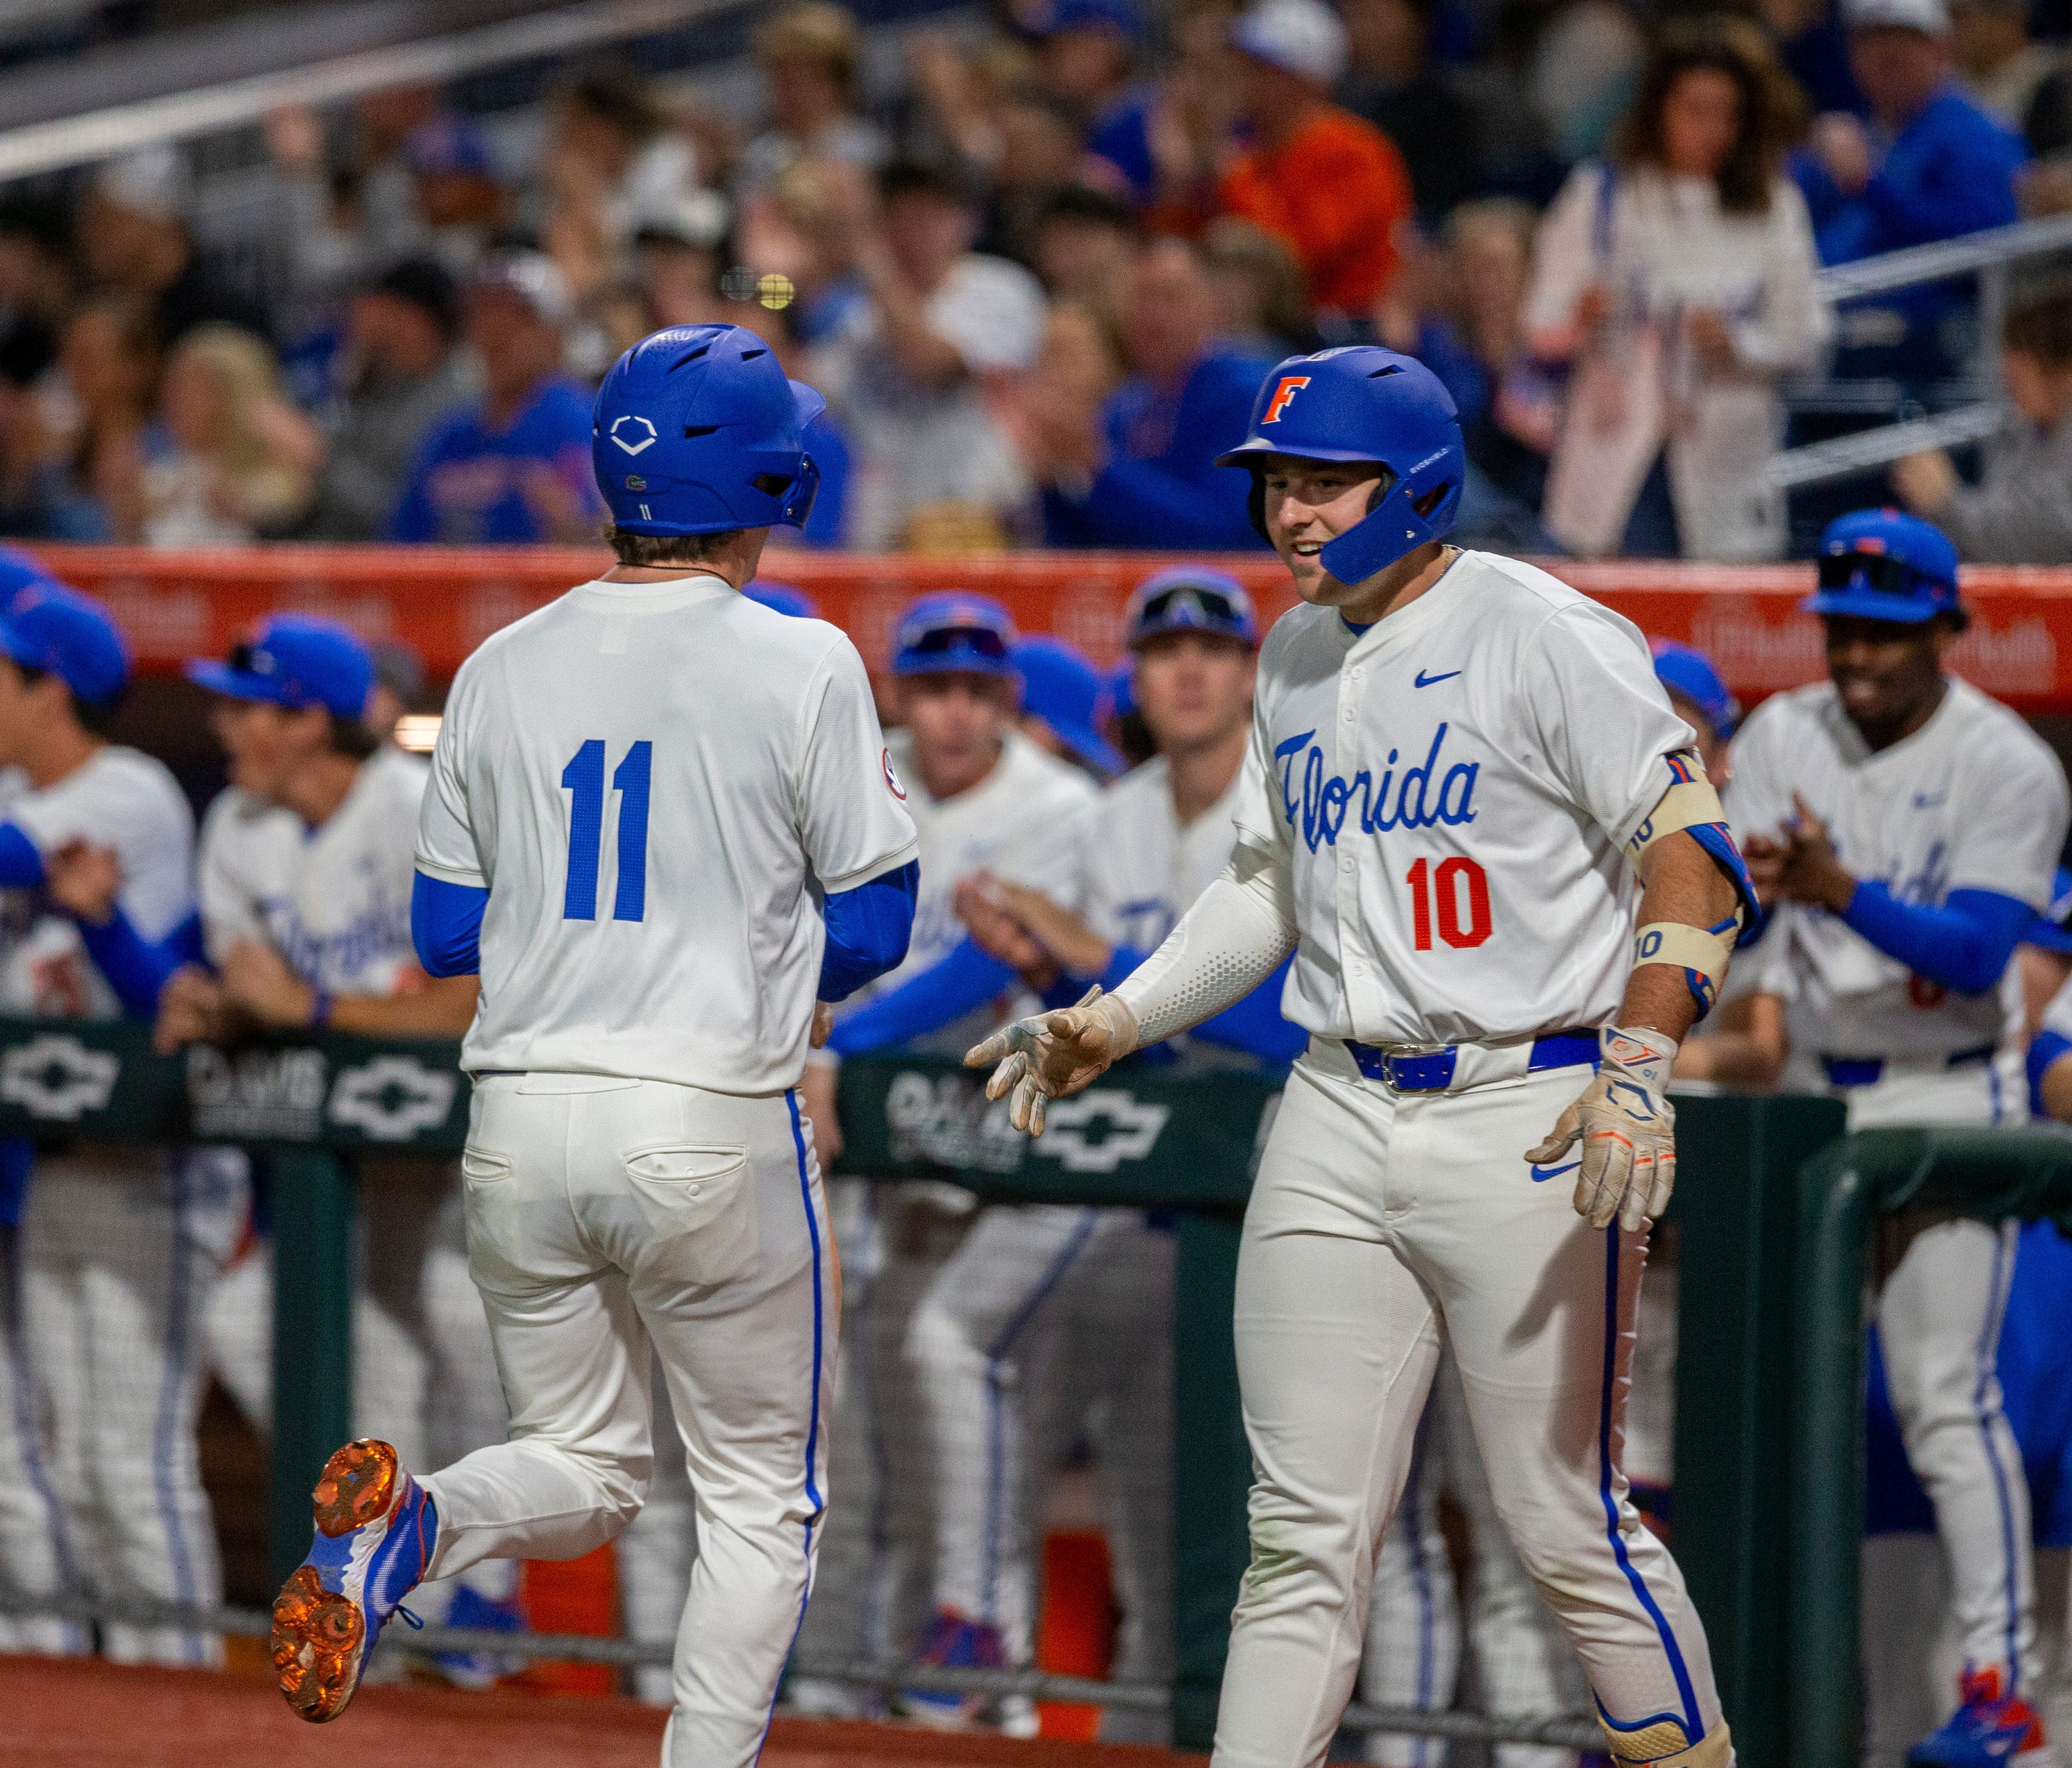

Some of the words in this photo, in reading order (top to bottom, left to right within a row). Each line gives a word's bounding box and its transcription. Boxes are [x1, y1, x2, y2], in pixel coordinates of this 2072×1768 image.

[1261, 376, 1312, 424] F
[639, 504, 652, 520] 11
[561, 739, 652, 922] 11
[1275, 722, 1480, 854] Florida
[1406, 857, 1493, 951] 10
